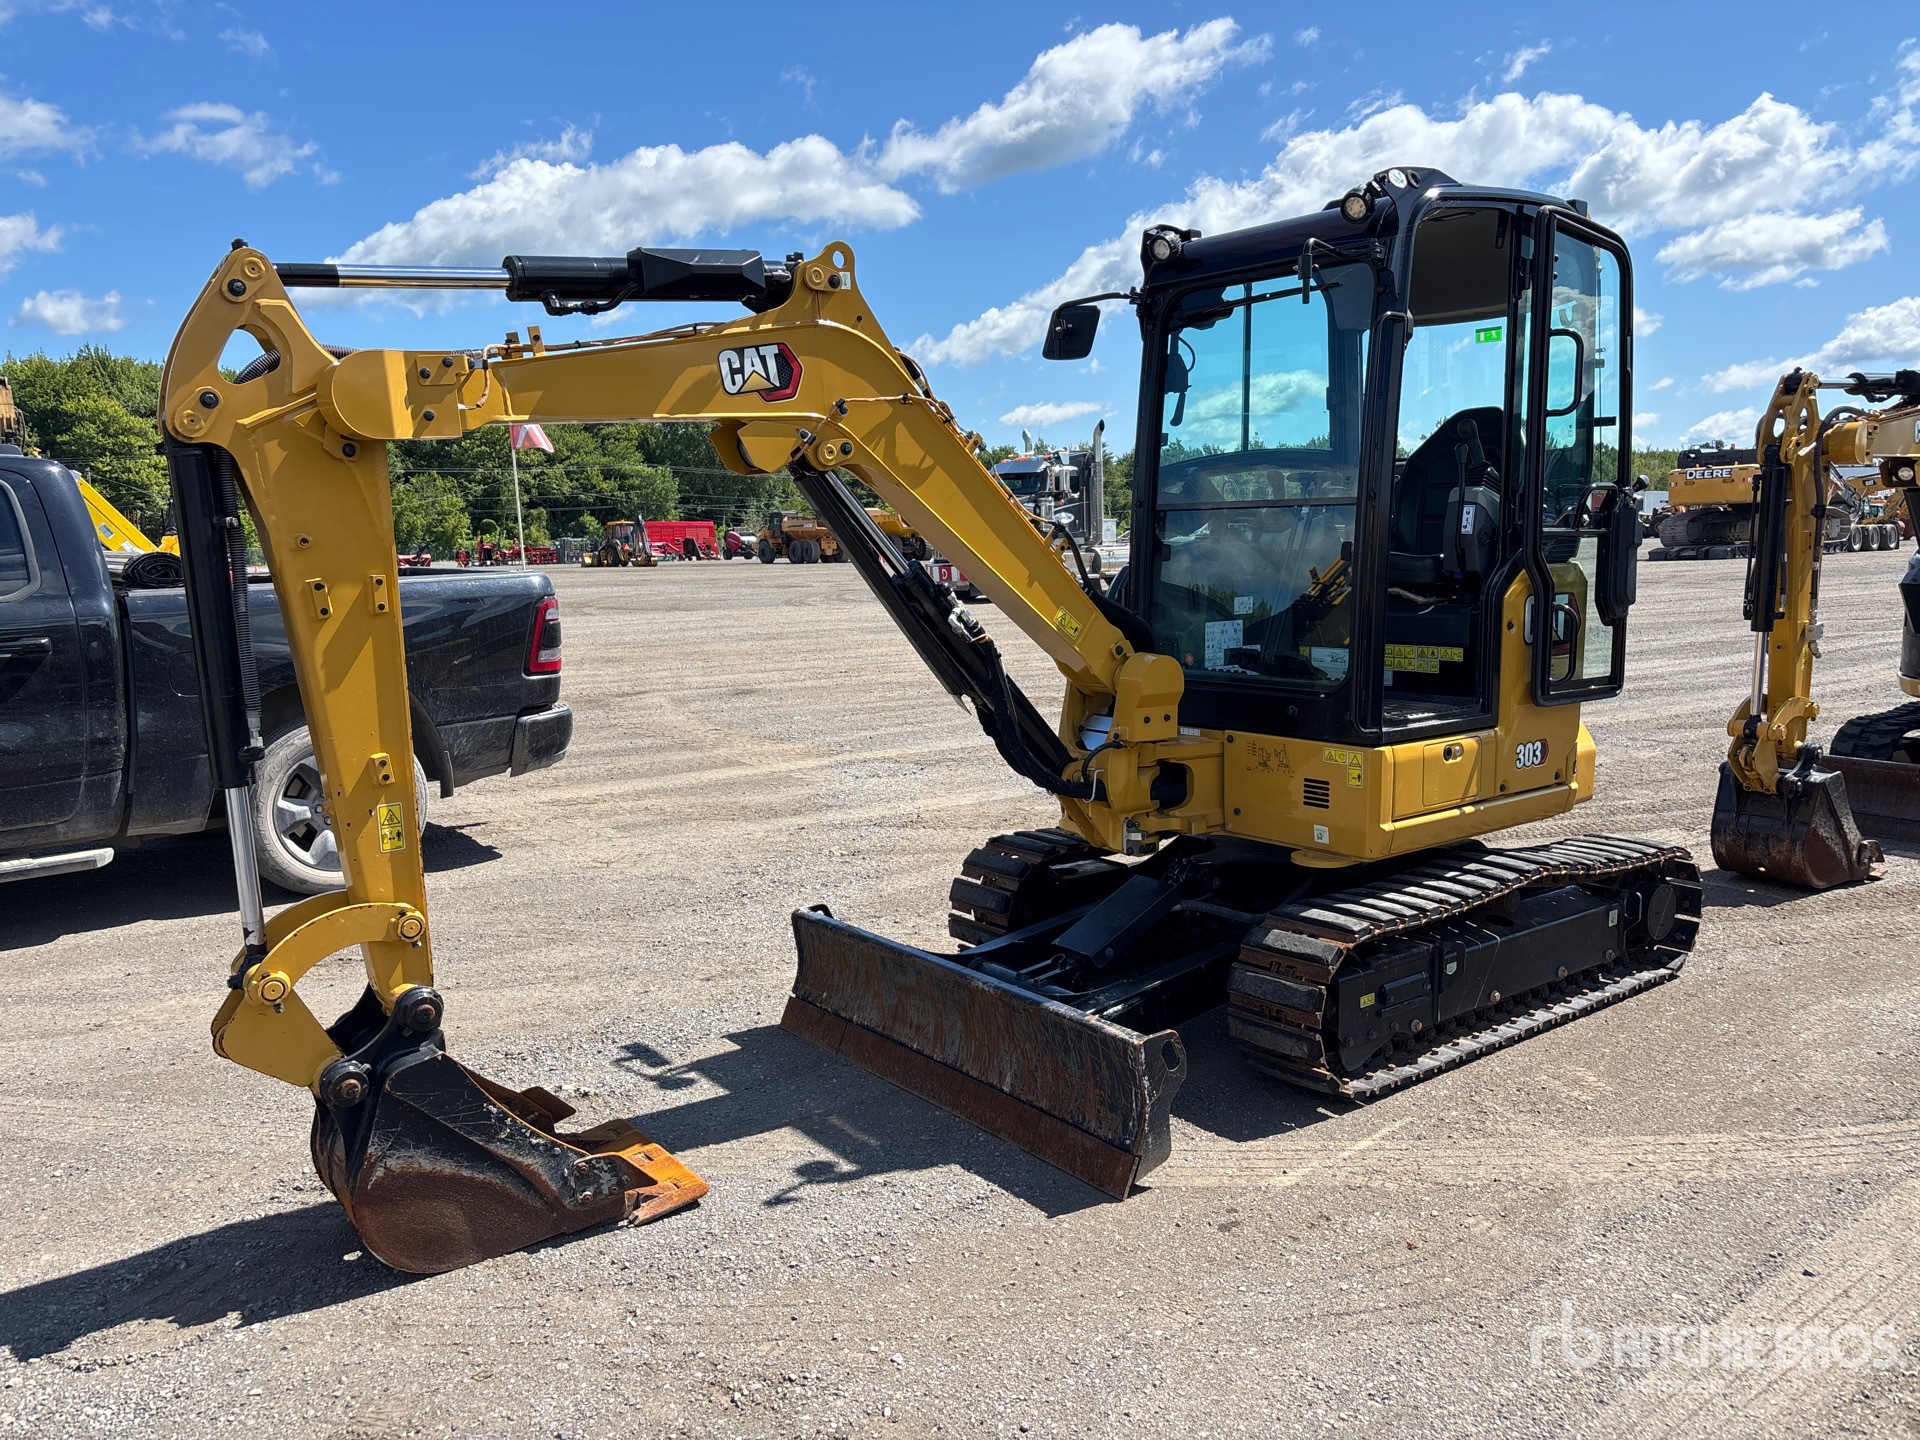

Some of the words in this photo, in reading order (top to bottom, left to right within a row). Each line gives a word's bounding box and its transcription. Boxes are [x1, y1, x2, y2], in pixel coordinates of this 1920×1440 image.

[719, 344, 780, 394] CAT
[1686, 468, 1731, 479] DEERE
[941, 568, 948, 579] D
[1516, 741, 1541, 768] 303
